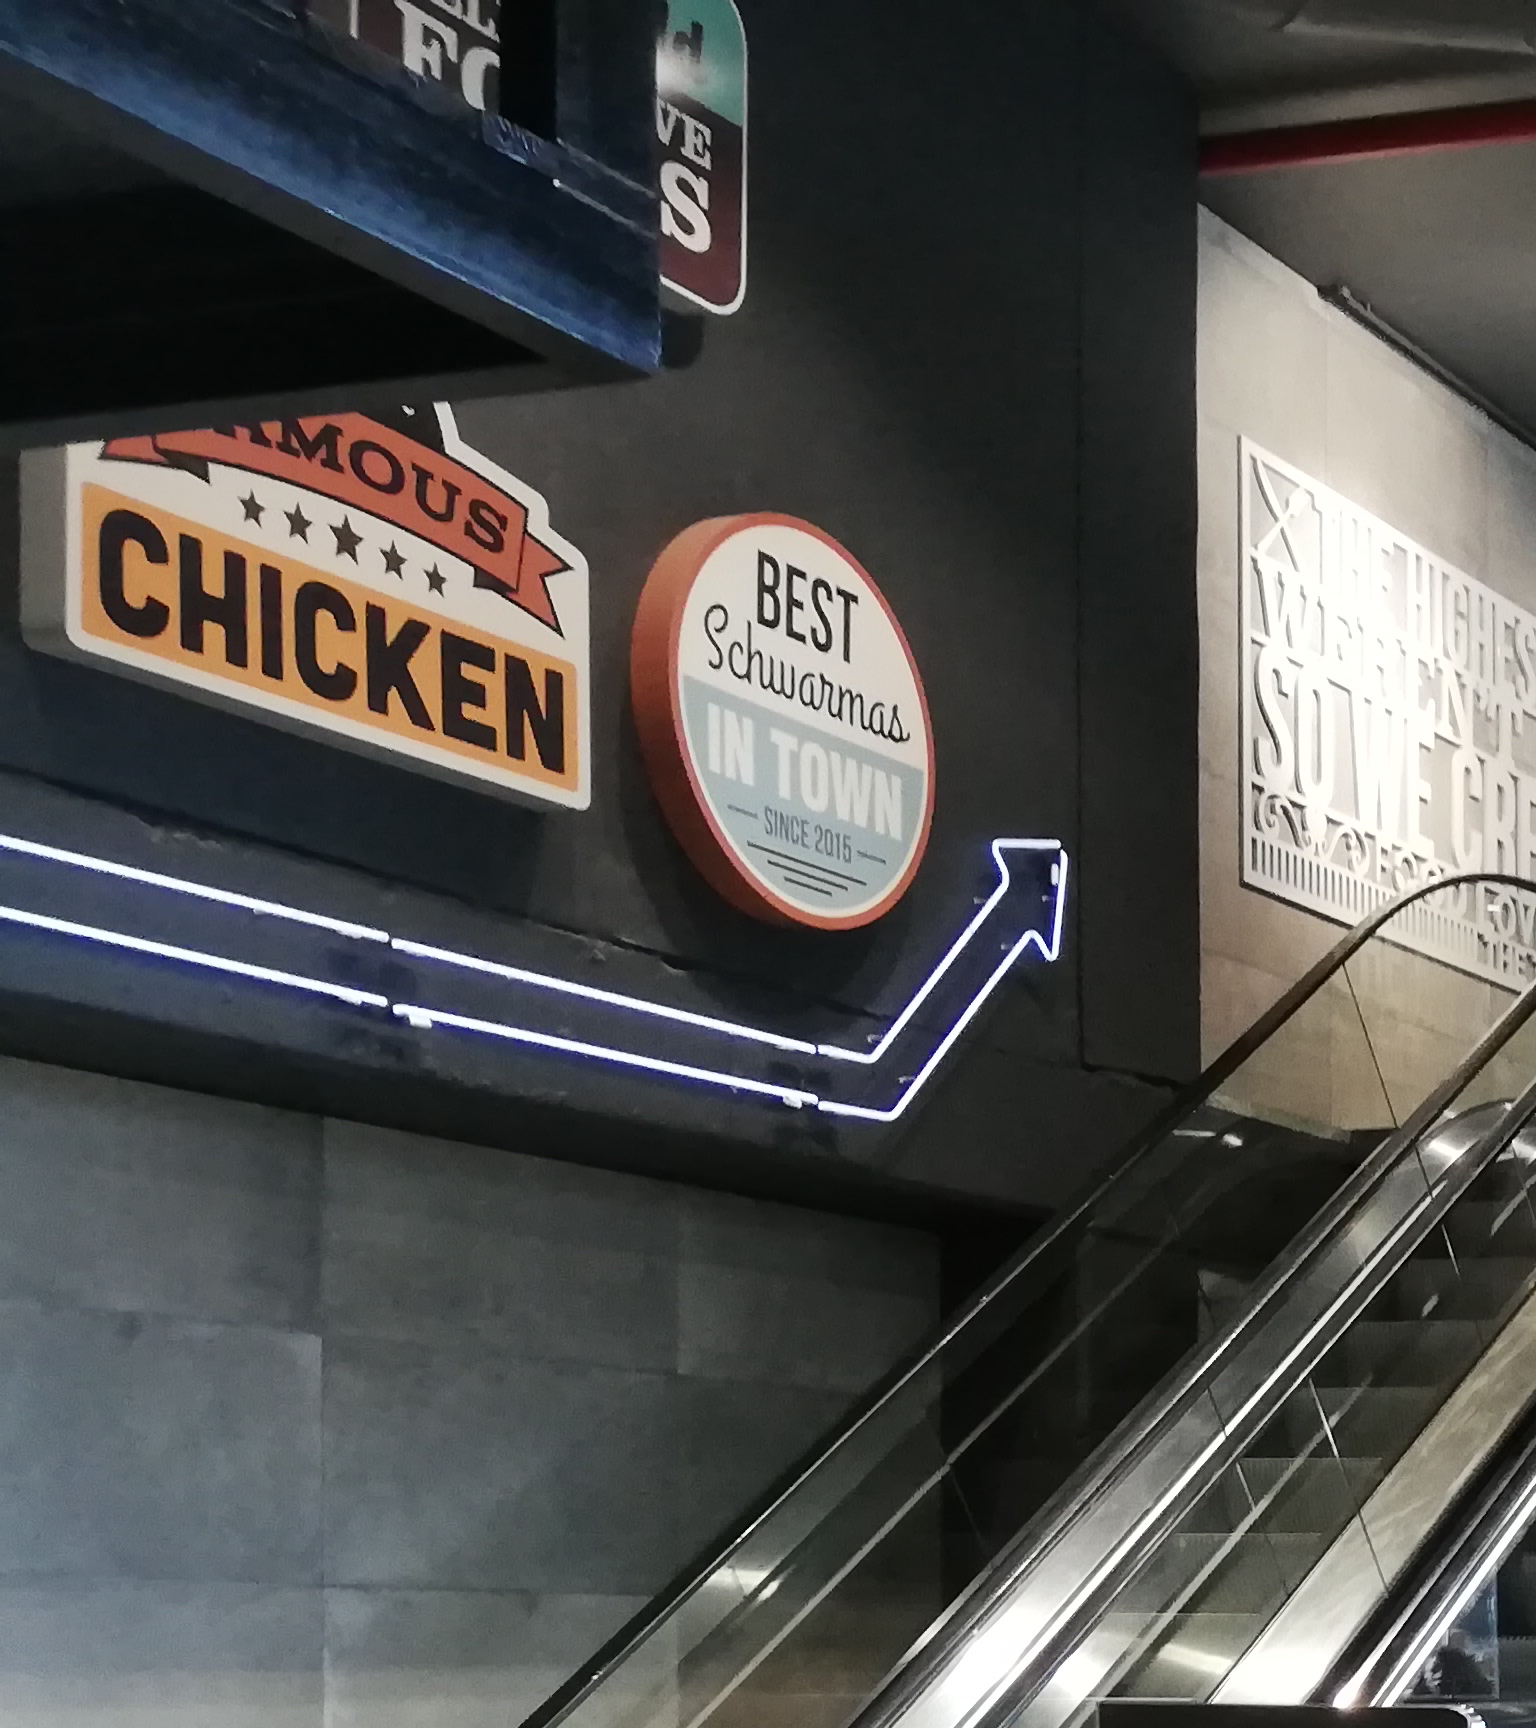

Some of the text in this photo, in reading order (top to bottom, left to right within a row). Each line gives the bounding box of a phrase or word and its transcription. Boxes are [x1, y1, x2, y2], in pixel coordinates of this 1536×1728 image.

[212, 415, 508, 554] AMOUS
[98, 507, 567, 775] CHICKEN
[704, 603, 910, 743] Schwarmas
[757, 549, 858, 663] BEST
[707, 702, 902, 841] IN TOWN
[1251, 647, 1334, 812] SO
[764, 806, 810, 850] SINCE
